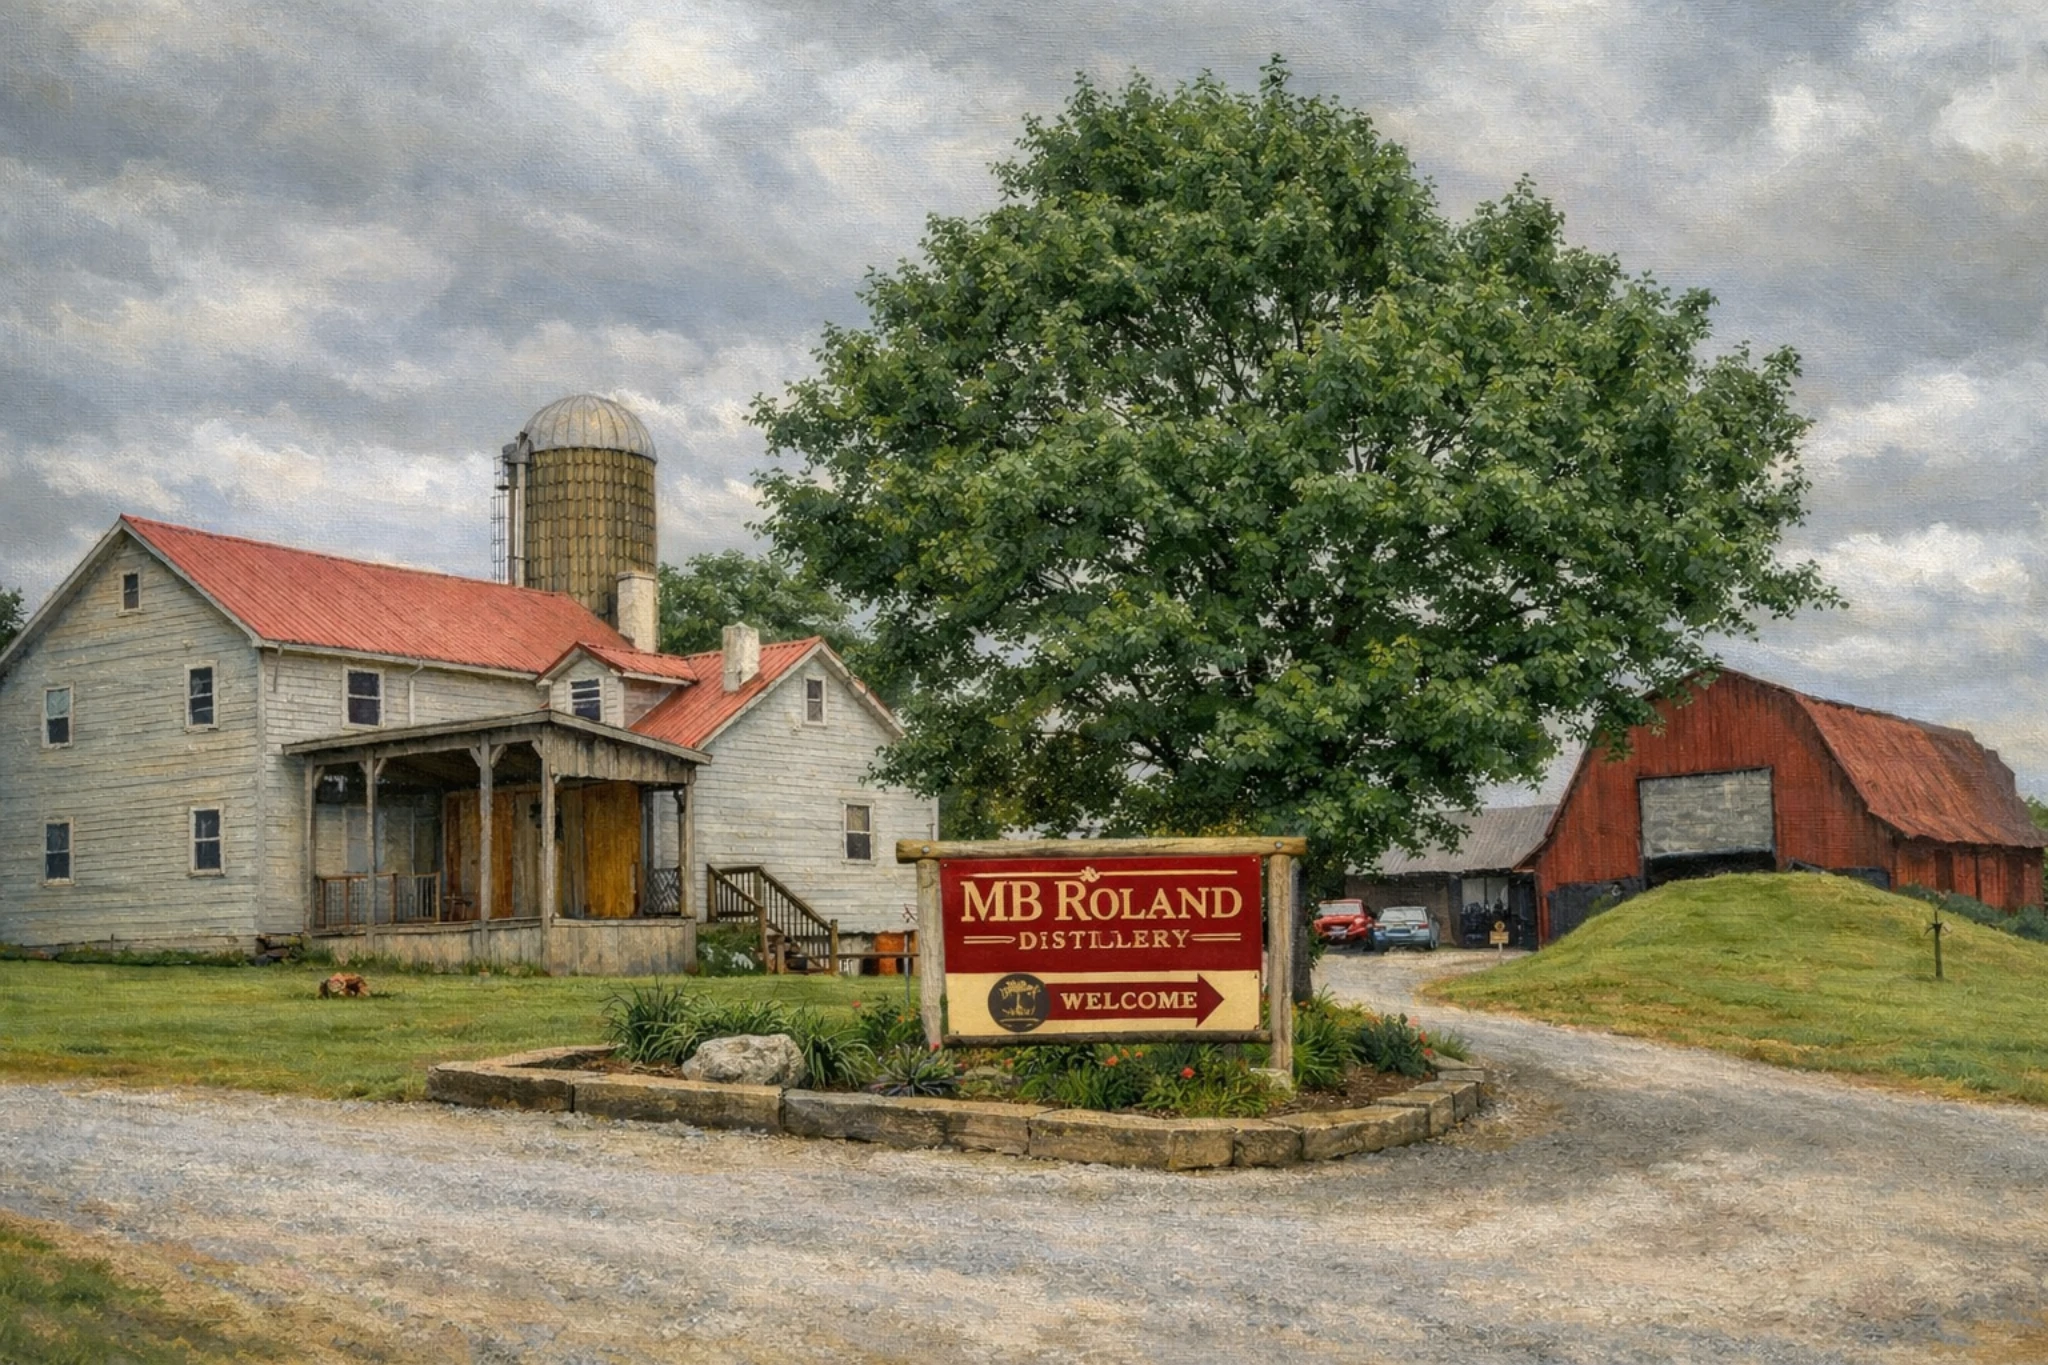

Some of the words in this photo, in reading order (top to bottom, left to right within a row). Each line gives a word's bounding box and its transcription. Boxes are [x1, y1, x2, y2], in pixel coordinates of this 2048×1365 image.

[960, 880, 1042, 922] MB
[1018, 929, 1190, 950] DISTILLERY
[1060, 991, 1198, 1010] WELCOME
